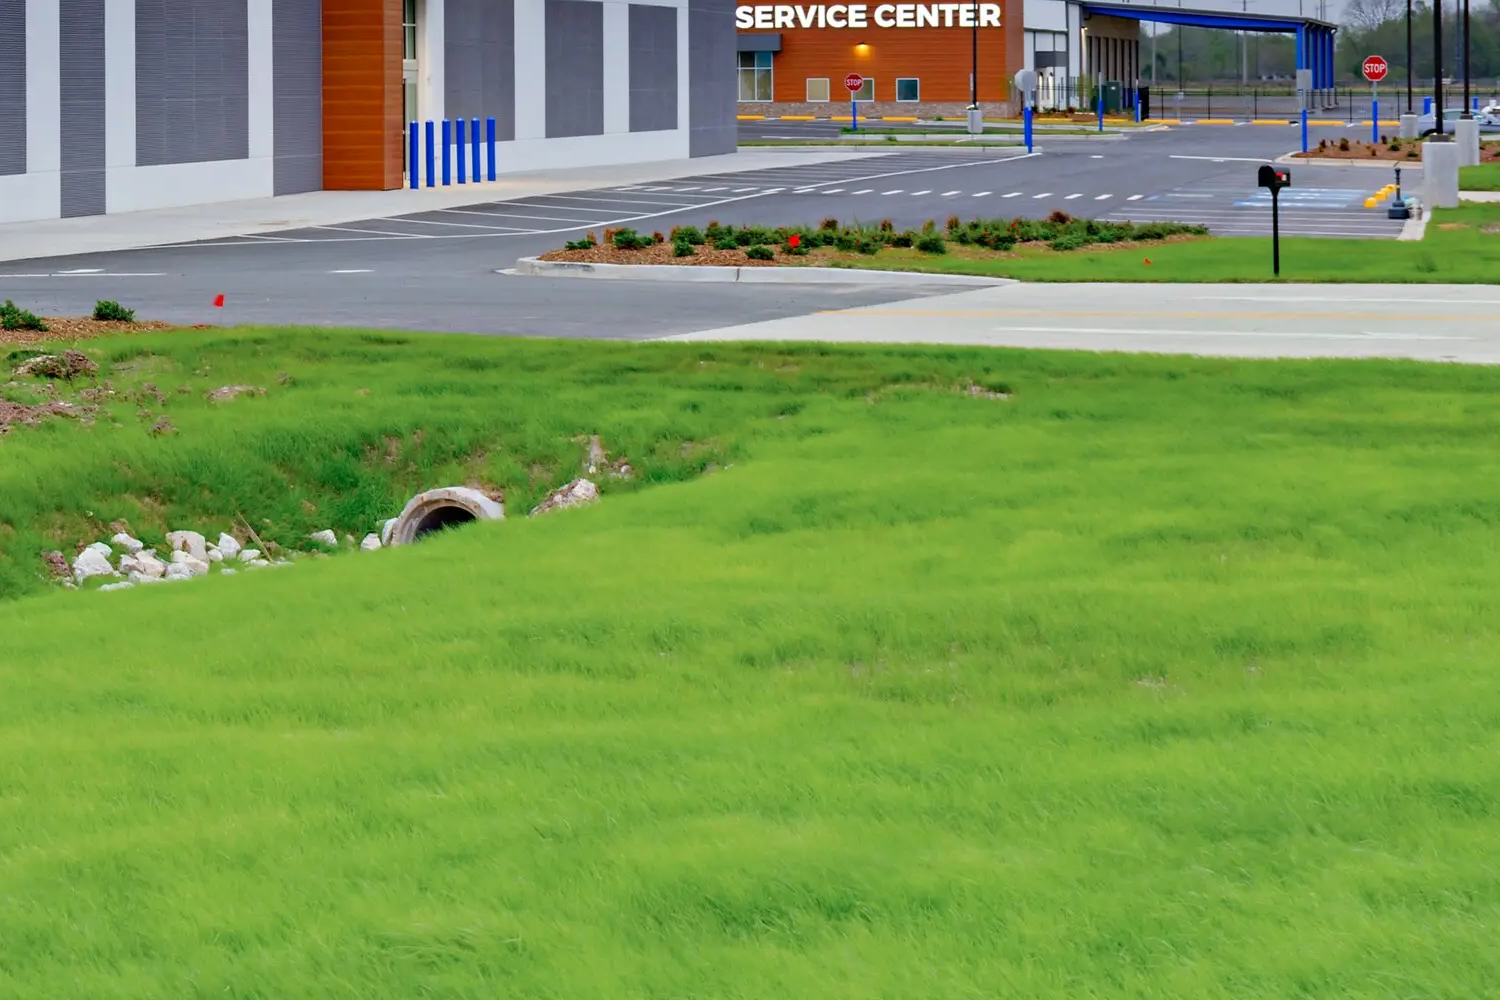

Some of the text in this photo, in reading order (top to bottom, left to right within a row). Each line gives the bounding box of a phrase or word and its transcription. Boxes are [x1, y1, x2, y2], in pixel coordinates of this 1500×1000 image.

[735, 3, 1002, 29] SERVICE CENTER
[1364, 63, 1386, 74] STOP
[846, 78, 862, 87] STOP
